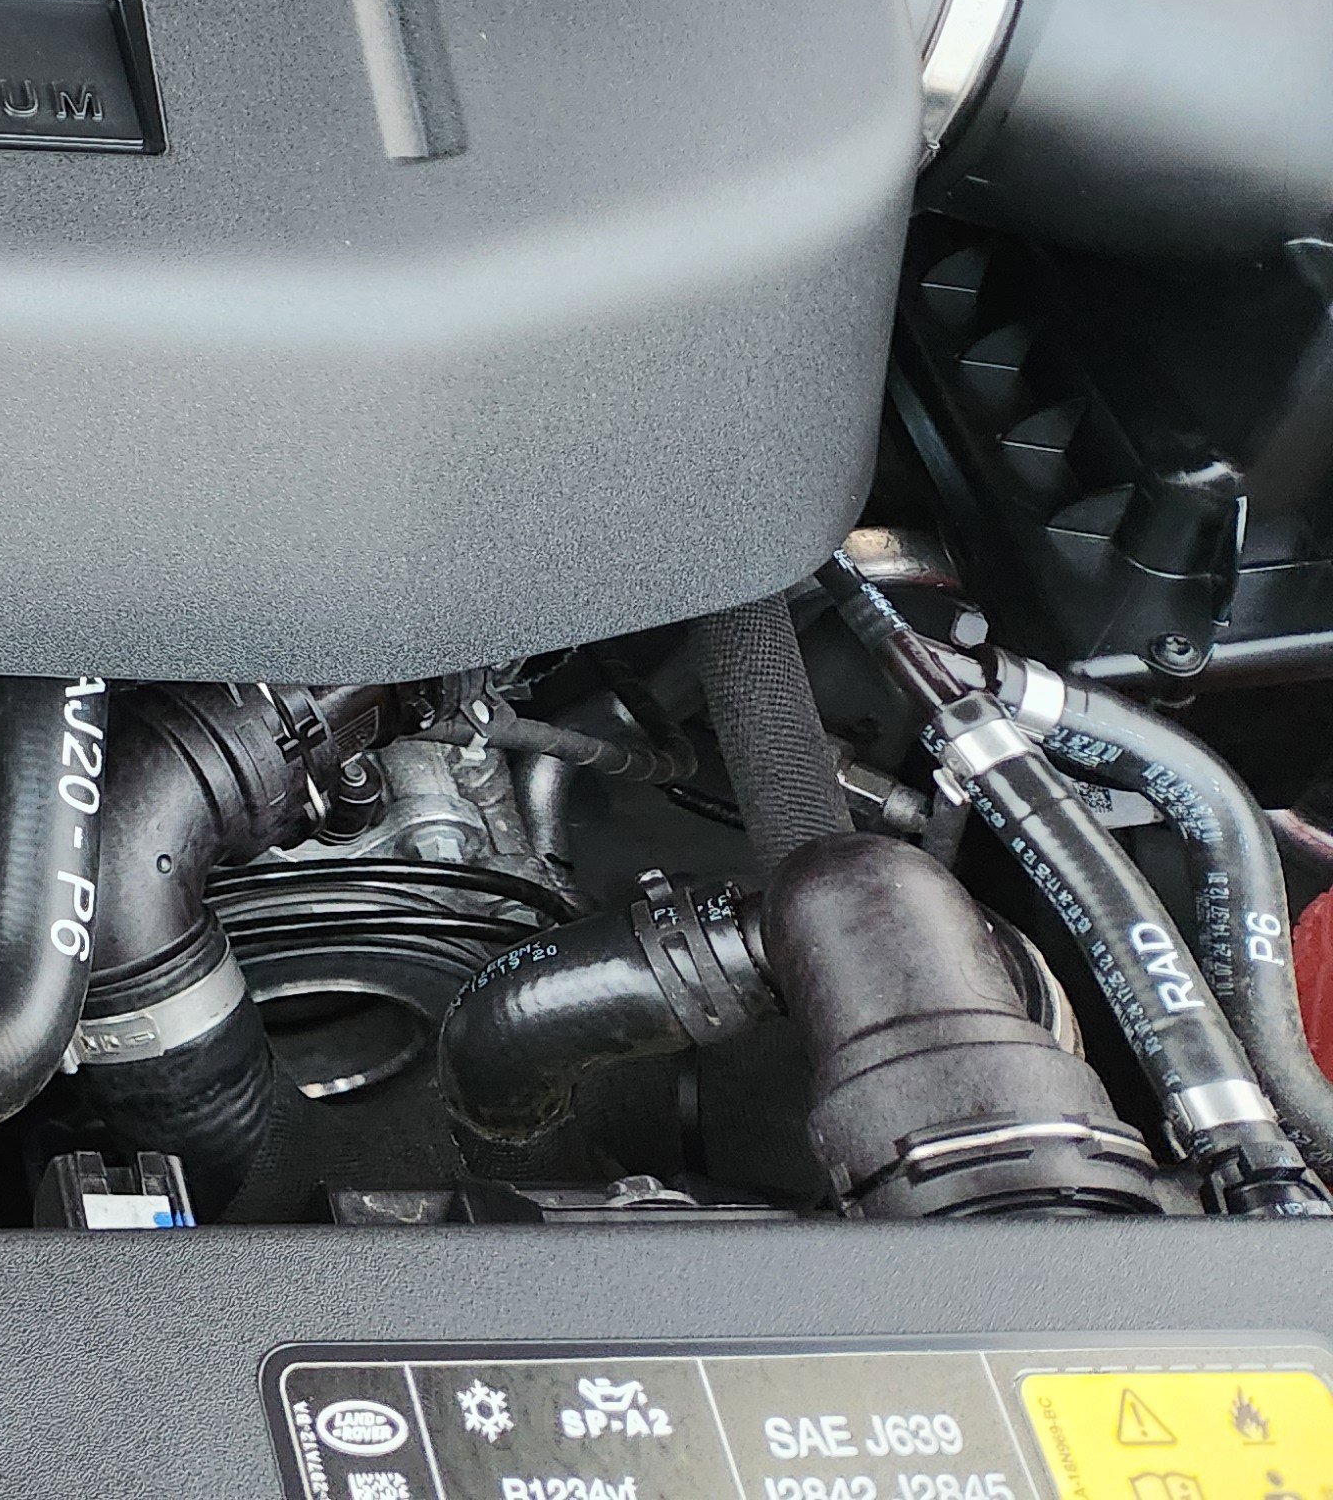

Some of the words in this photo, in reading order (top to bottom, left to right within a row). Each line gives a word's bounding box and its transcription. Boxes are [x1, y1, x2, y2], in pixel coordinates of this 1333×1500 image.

[49, 869, 97, 963] P6
[1245, 909, 1284, 967] P6
[1130, 921, 1205, 1014] RAD
[334, 1411, 376, 1427] LAND
[341, 1425, 393, 1443] ROVER
[561, 1408, 673, 1439] SP-A2
[764, 1415, 859, 1459] SAE
[865, 1413, 964, 1457] J639
